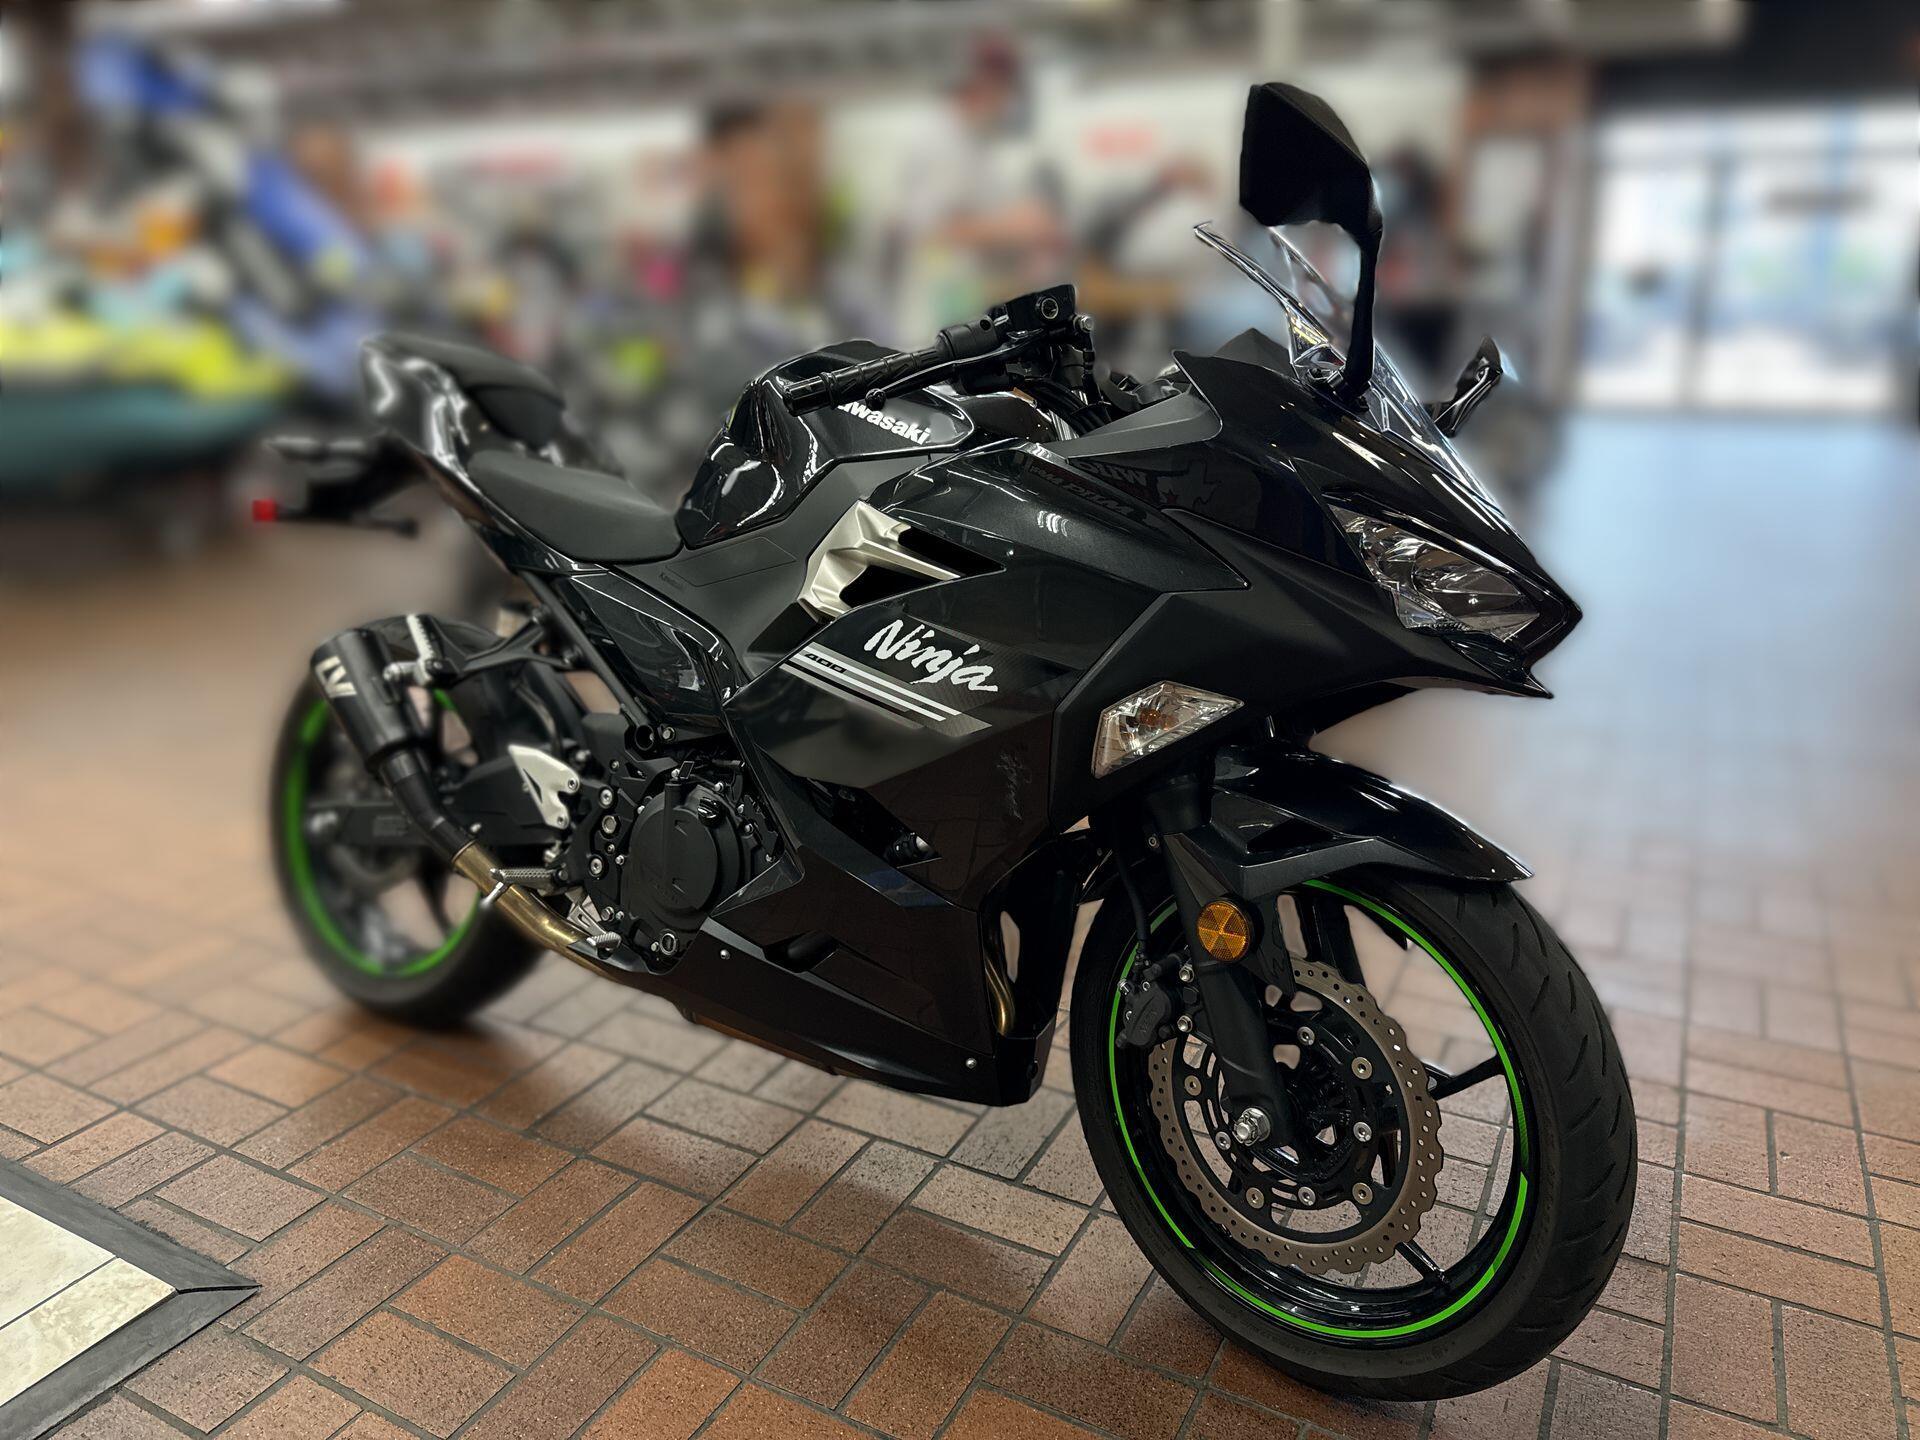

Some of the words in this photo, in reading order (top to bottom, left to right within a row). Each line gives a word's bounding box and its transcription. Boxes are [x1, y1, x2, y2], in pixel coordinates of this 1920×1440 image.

[837, 401, 932, 446] wasaki
[804, 653, 847, 673] 400
[864, 619, 998, 692] Ninja
